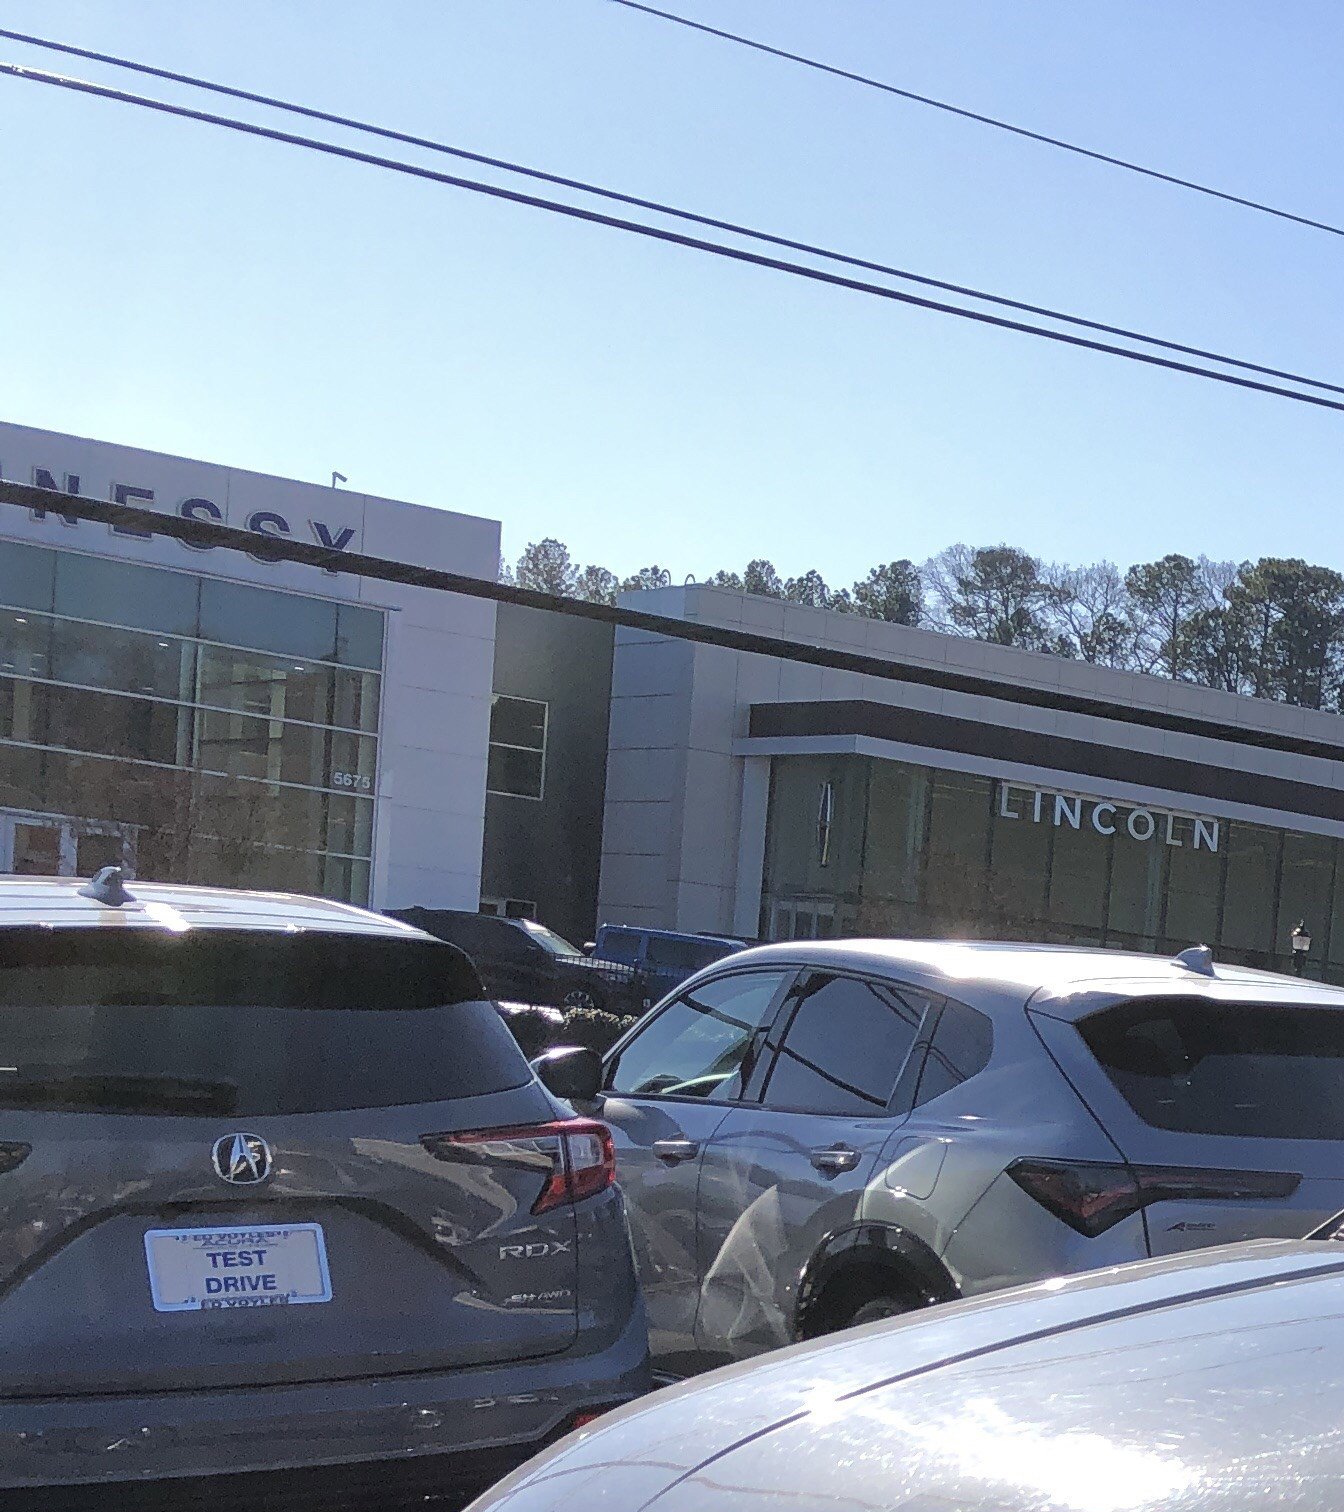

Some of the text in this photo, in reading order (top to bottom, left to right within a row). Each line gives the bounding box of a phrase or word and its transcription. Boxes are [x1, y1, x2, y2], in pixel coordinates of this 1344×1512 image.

[0, 465, 356, 576] NESSY
[1001, 782, 1220, 853] LINCOLN
[205, 1249, 267, 1269] TEST
[500, 1238, 572, 1260] RDX
[205, 1274, 277, 1294] DRIVE
